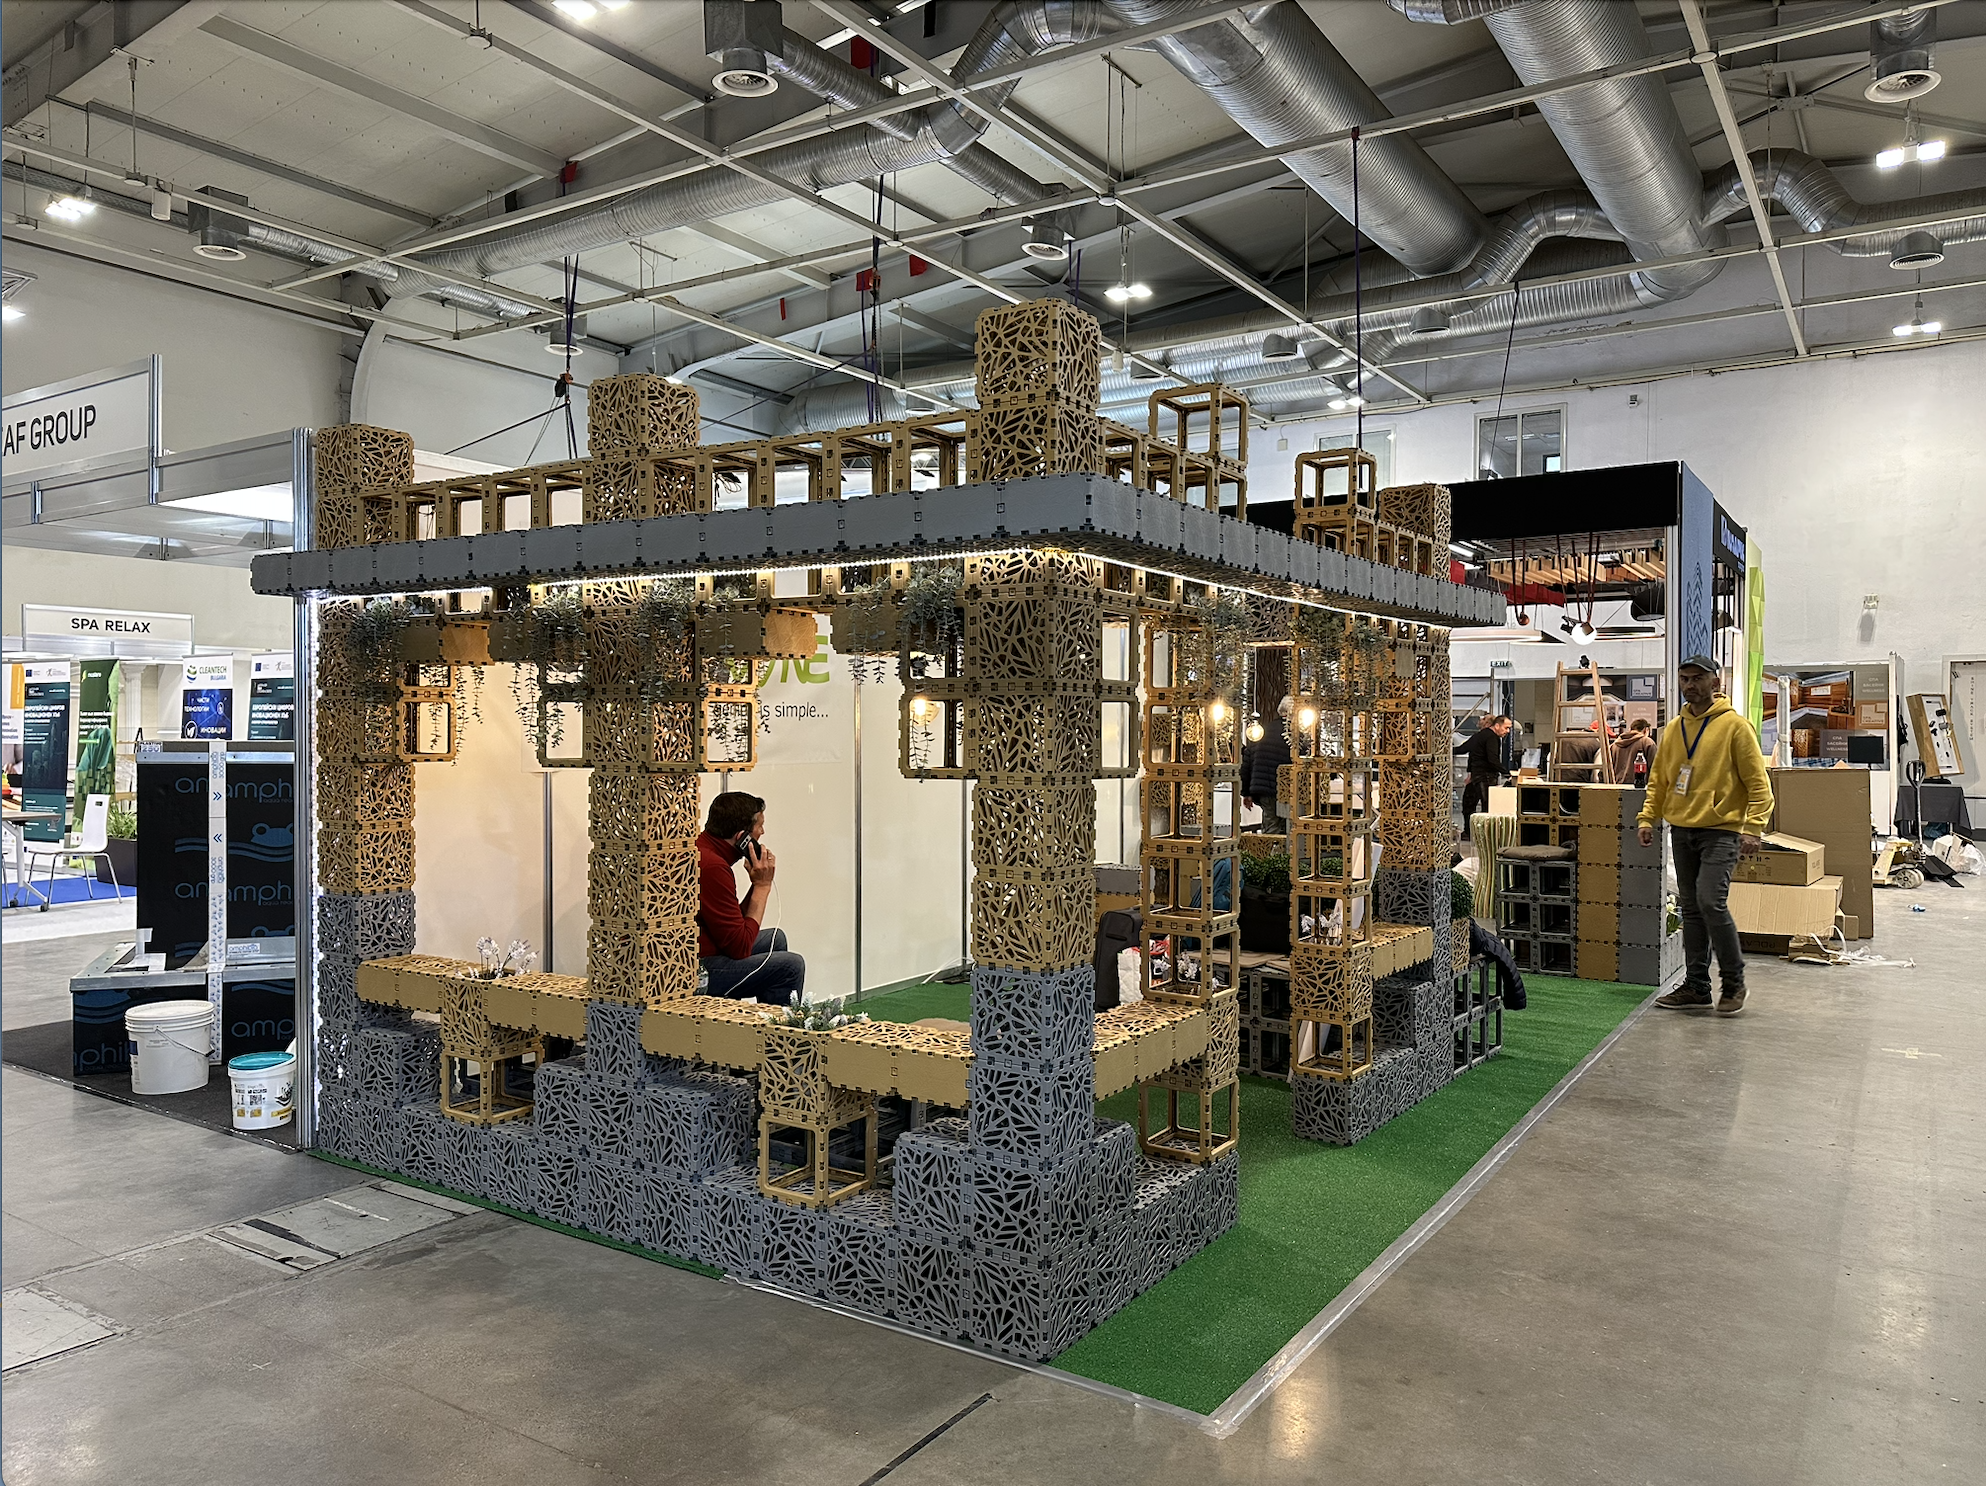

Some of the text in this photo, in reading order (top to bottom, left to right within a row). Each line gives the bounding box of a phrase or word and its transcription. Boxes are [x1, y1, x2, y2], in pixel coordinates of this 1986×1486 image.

[2, 404, 97, 456] AF GROUP
[71, 617, 151, 634] SPA RELAX
[199, 666, 227, 674] CLEANTECH
[775, 702, 829, 721] simple...
